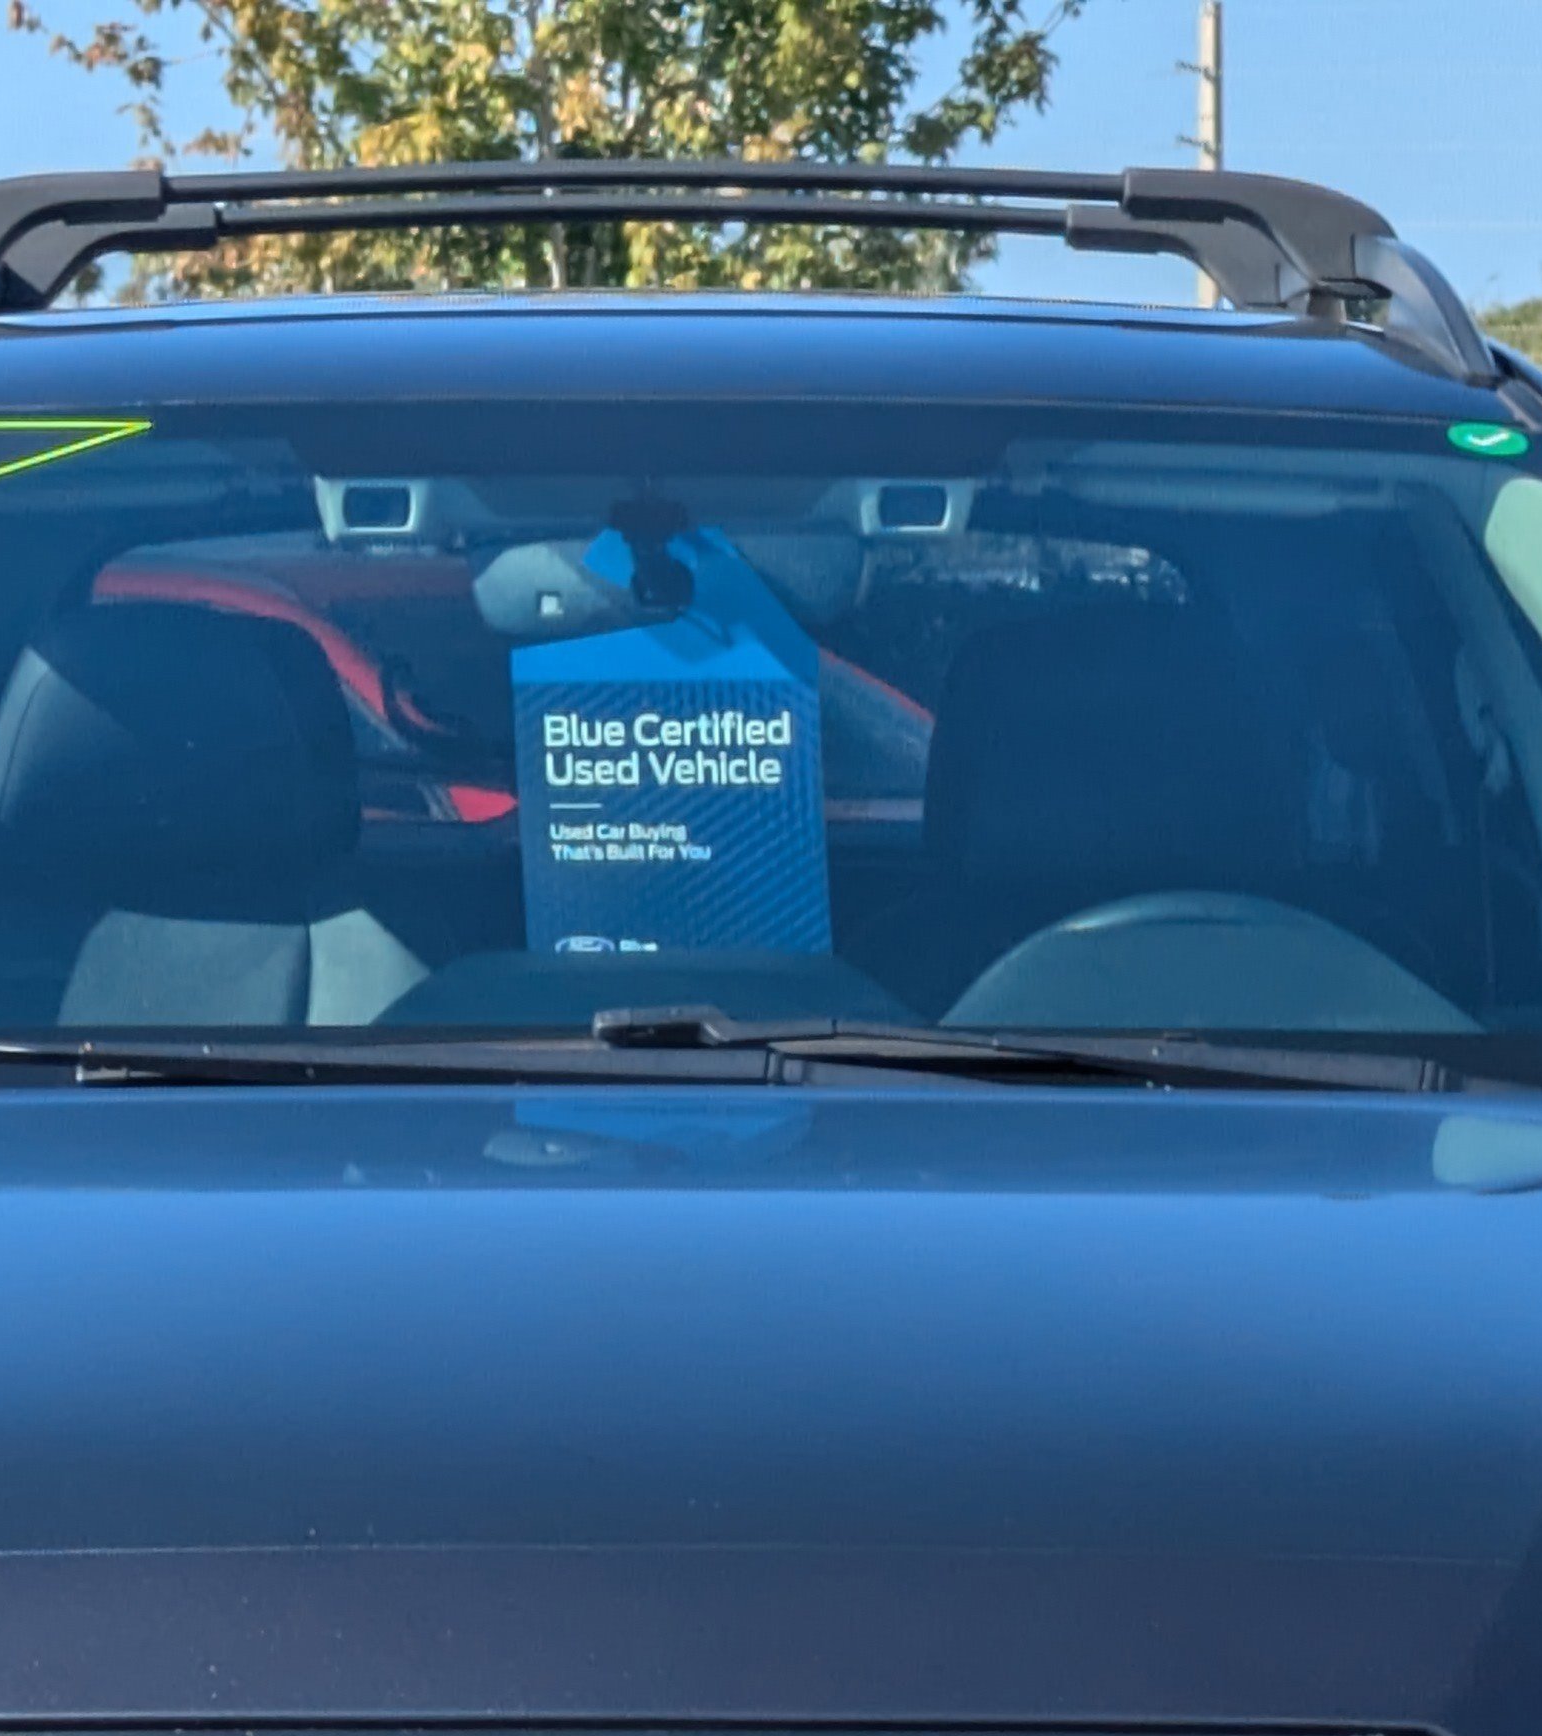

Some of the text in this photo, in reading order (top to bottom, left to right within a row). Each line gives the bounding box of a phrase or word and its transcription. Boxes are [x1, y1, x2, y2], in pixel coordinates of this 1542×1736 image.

[544, 711, 791, 747] Blue Certified
[546, 752, 782, 785] Used Vehicle
[550, 823, 688, 842] Used Car Buying
[551, 844, 712, 860] That's Built For You
